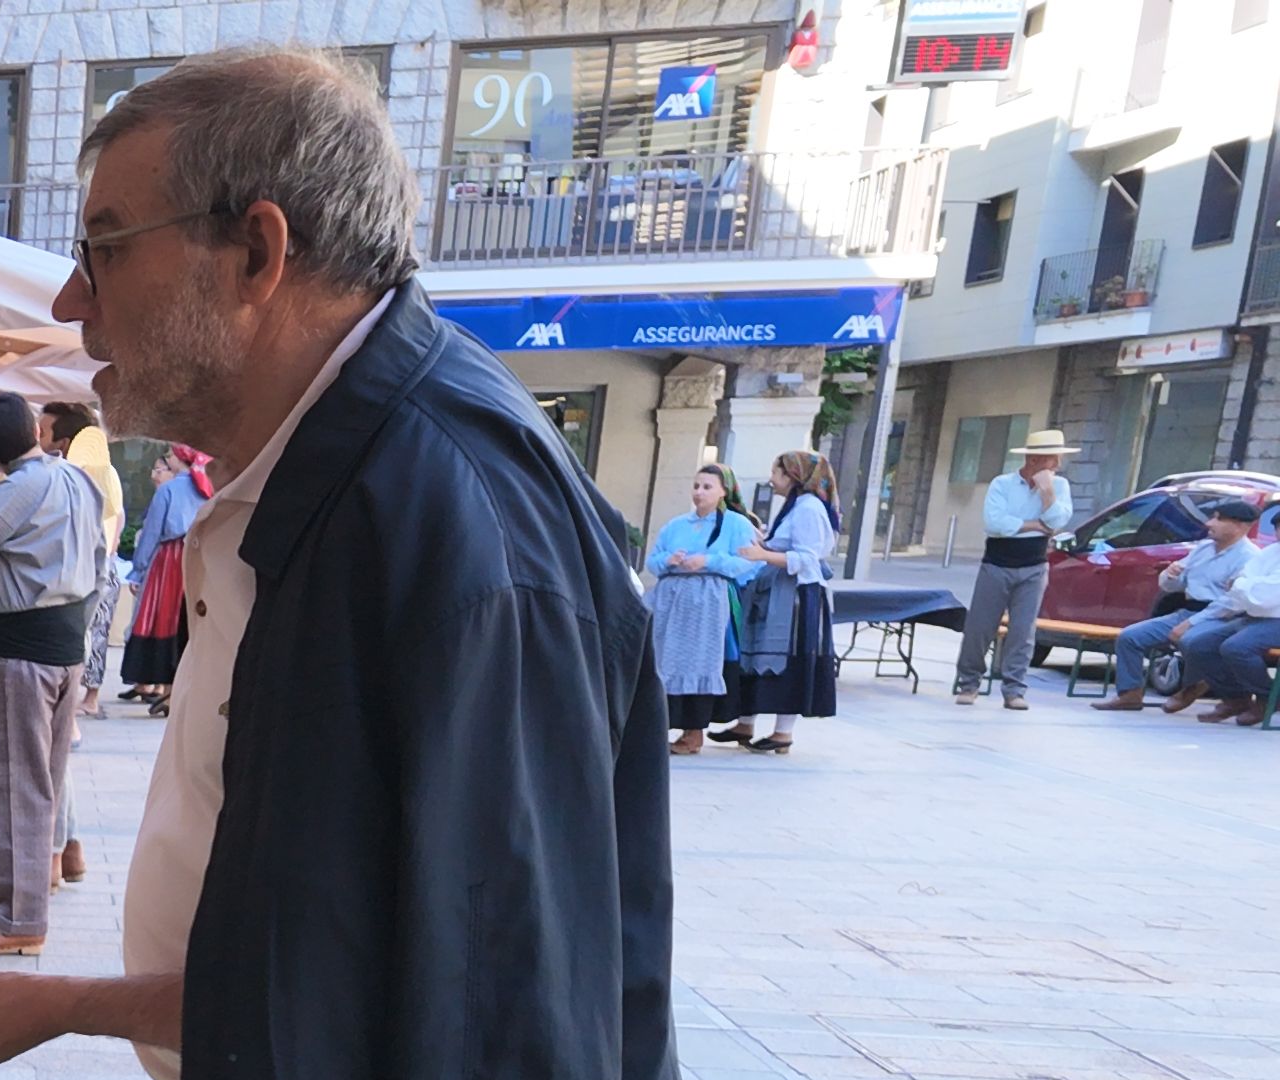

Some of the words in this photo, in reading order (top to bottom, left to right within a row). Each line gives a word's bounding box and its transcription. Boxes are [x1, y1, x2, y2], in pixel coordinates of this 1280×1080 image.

[914, 36, 1011, 72] 10:14
[470, 72, 553, 137] 90
[655, 93, 702, 117] AXA
[516, 322, 566, 347] AXA
[633, 325, 776, 344] ASSEGURANCES
[833, 315, 886, 339] AXA
